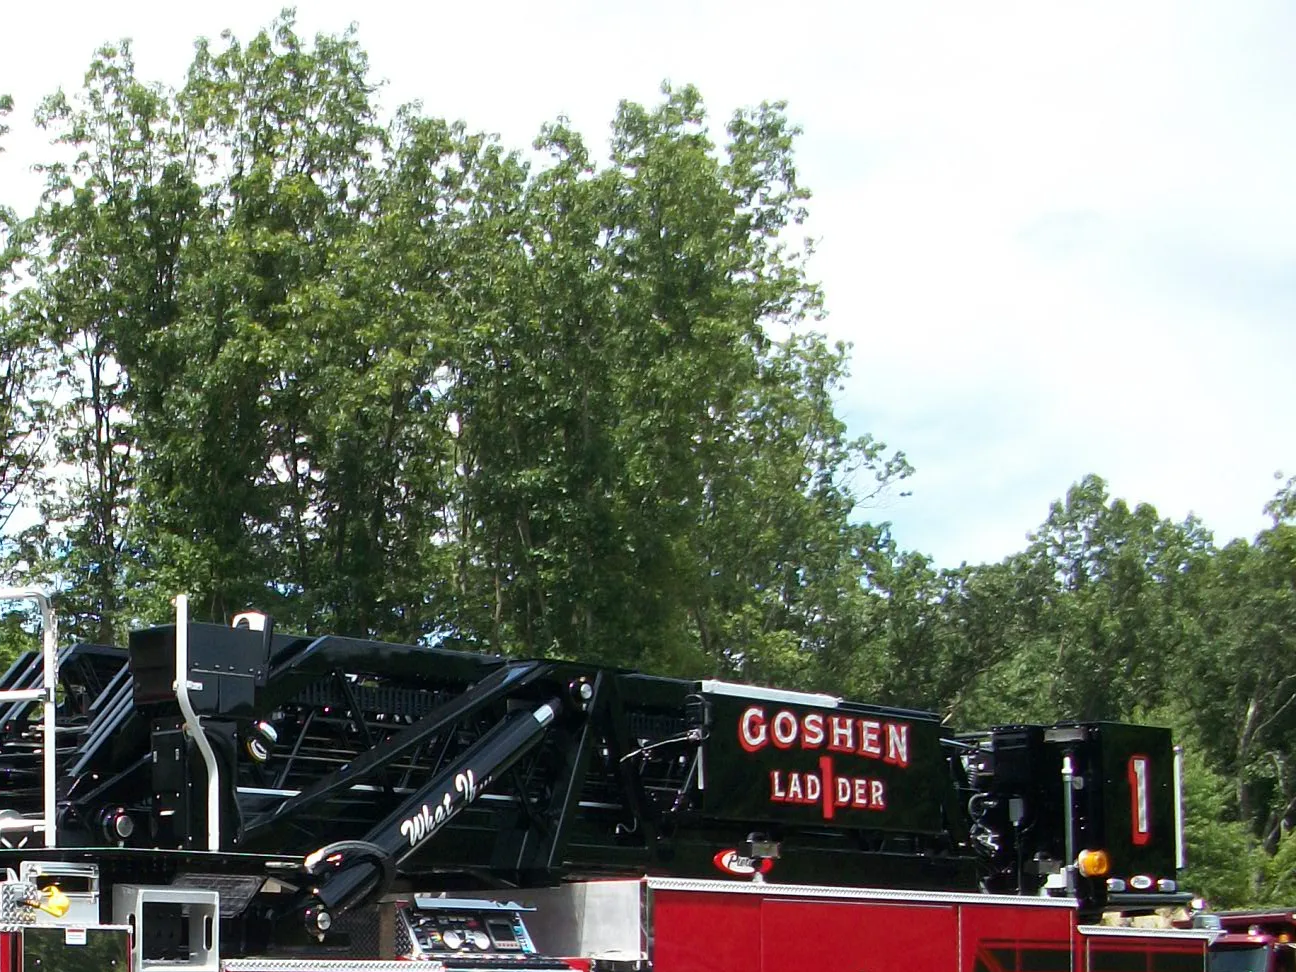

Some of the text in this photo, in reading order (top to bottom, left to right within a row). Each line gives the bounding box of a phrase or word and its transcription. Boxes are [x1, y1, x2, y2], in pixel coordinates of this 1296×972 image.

[740, 706, 910, 767] GOSHEN
[401, 793, 453, 846] What
[1128, 755, 1150, 845] 1
